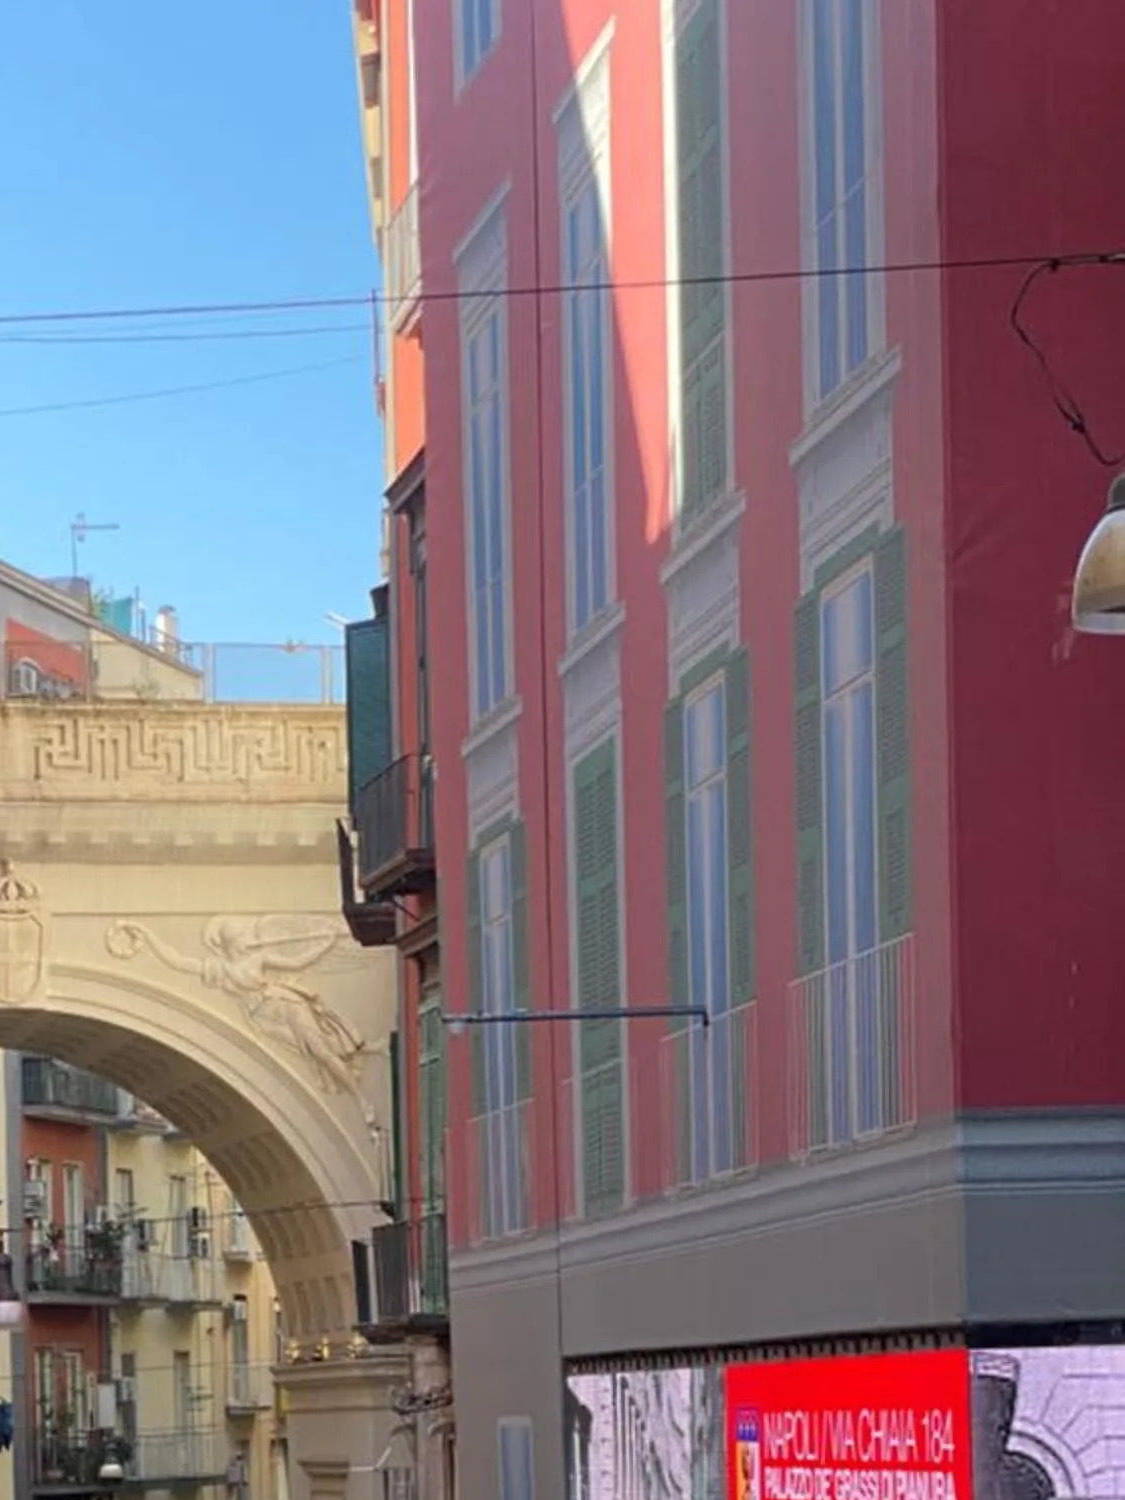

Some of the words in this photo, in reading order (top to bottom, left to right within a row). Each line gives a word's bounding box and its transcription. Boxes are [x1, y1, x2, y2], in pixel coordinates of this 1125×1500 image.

[763, 1409, 819, 1461] NAPOLI
[857, 1408, 919, 1462] CHIAIA
[921, 1409, 955, 1463] 184
